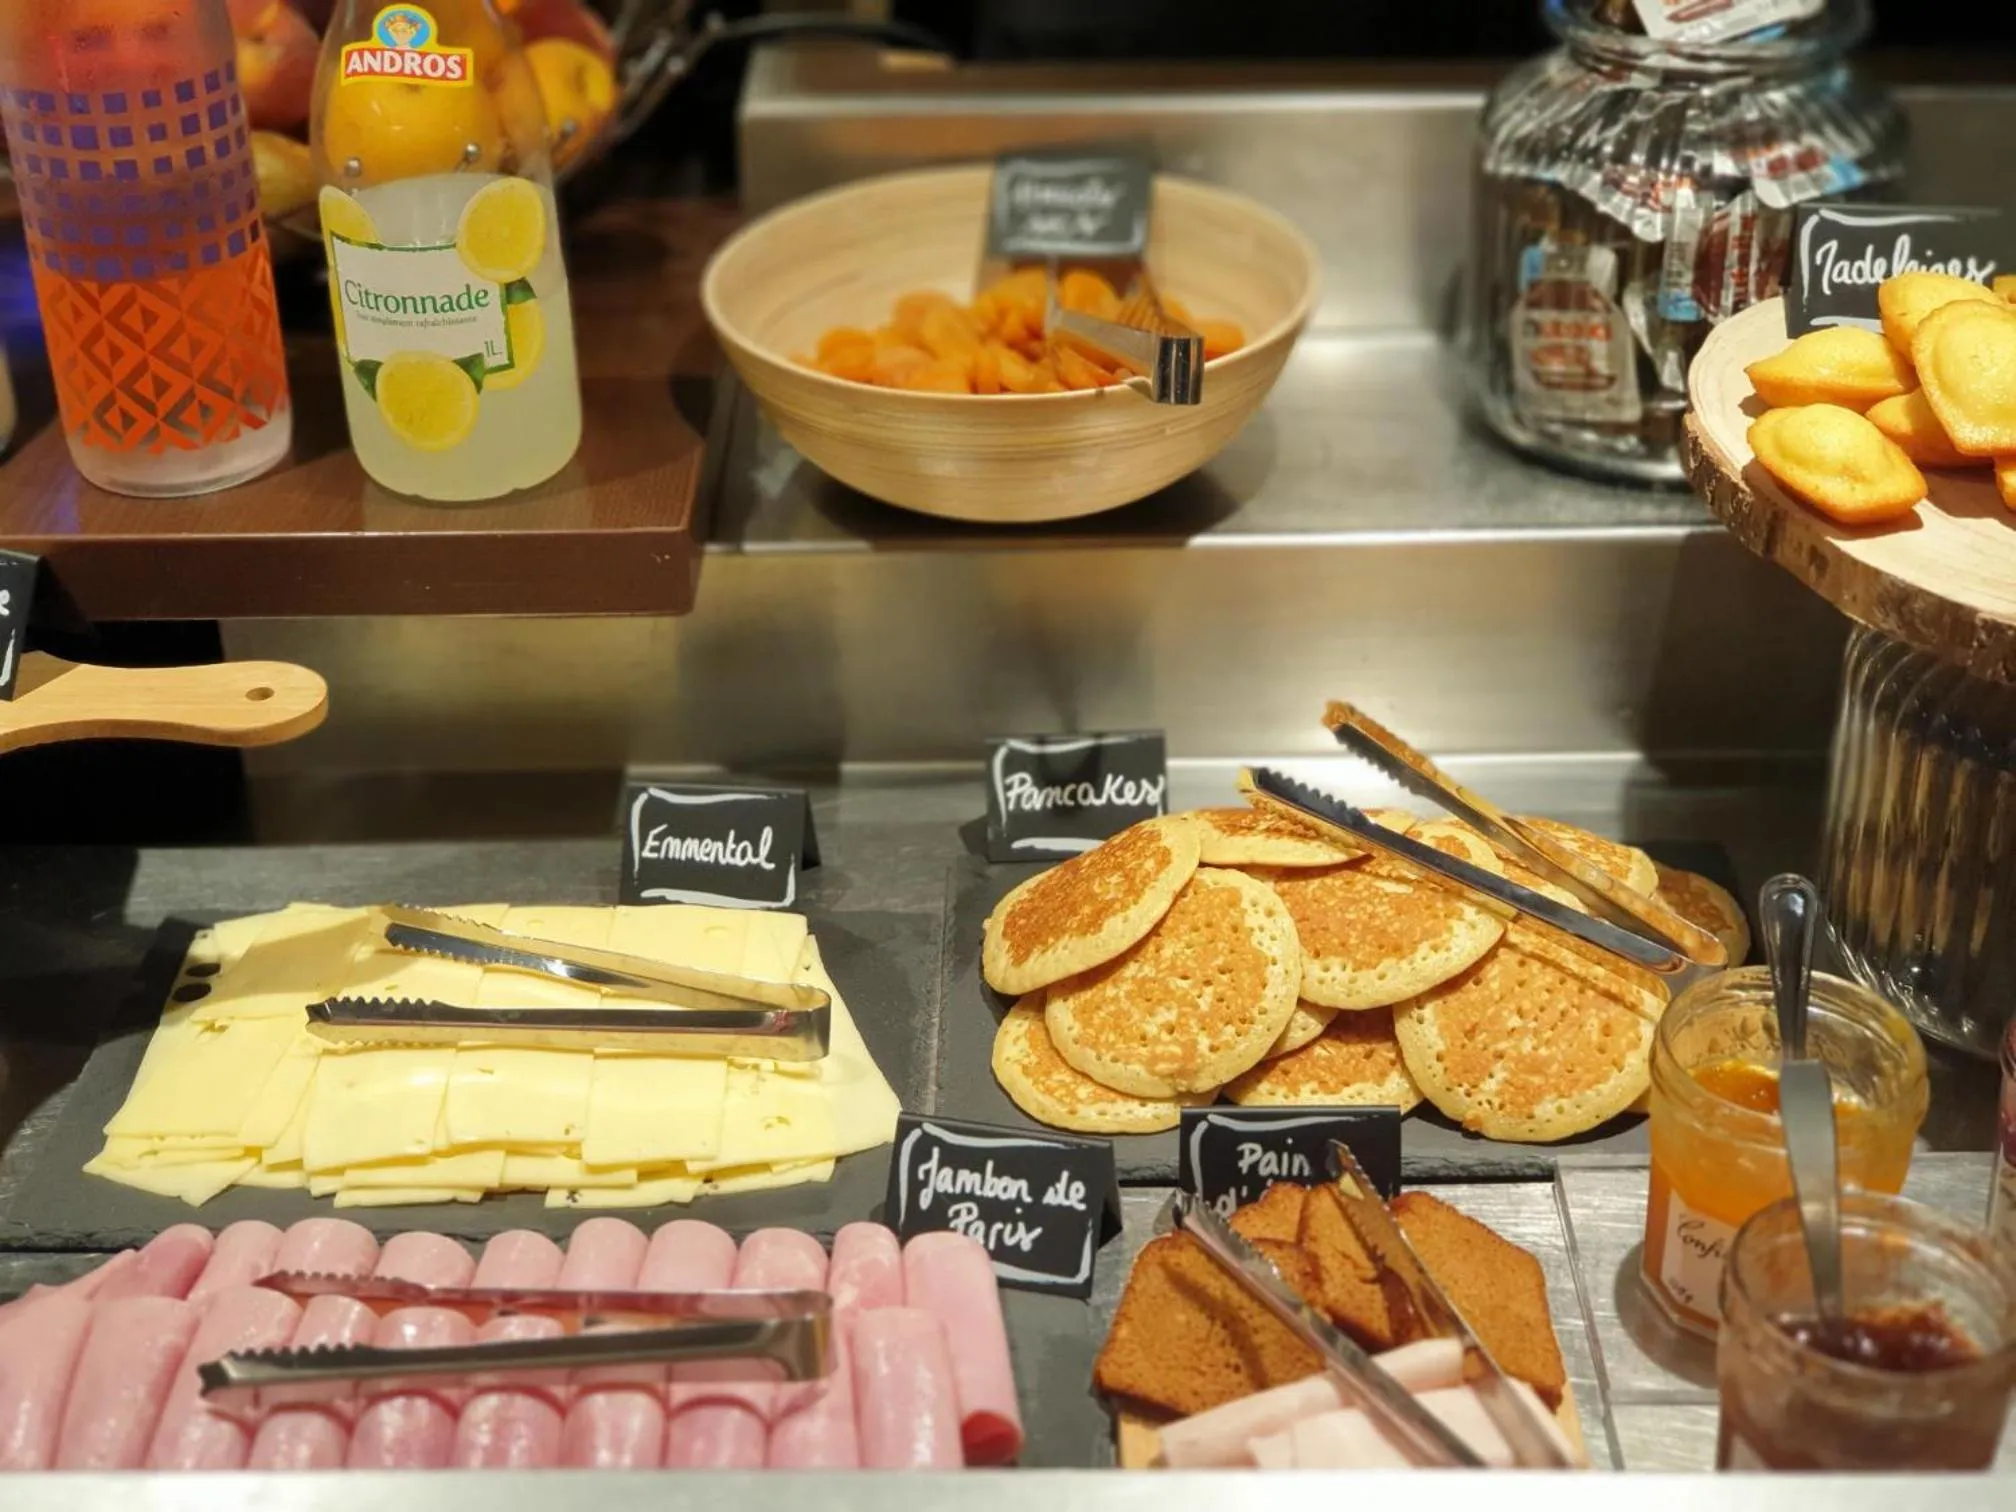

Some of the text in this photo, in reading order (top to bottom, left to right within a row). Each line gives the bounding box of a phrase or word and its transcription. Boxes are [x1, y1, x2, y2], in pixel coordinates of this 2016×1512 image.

[346, 50, 463, 79] ANDROS
[344, 279, 489, 314] Citronnade
[641, 823, 776, 870] Emmental
[1236, 1136, 1312, 1177] Pain
[917, 1146, 1088, 1212] Jambon de
[947, 1201, 1043, 1251] Paris
